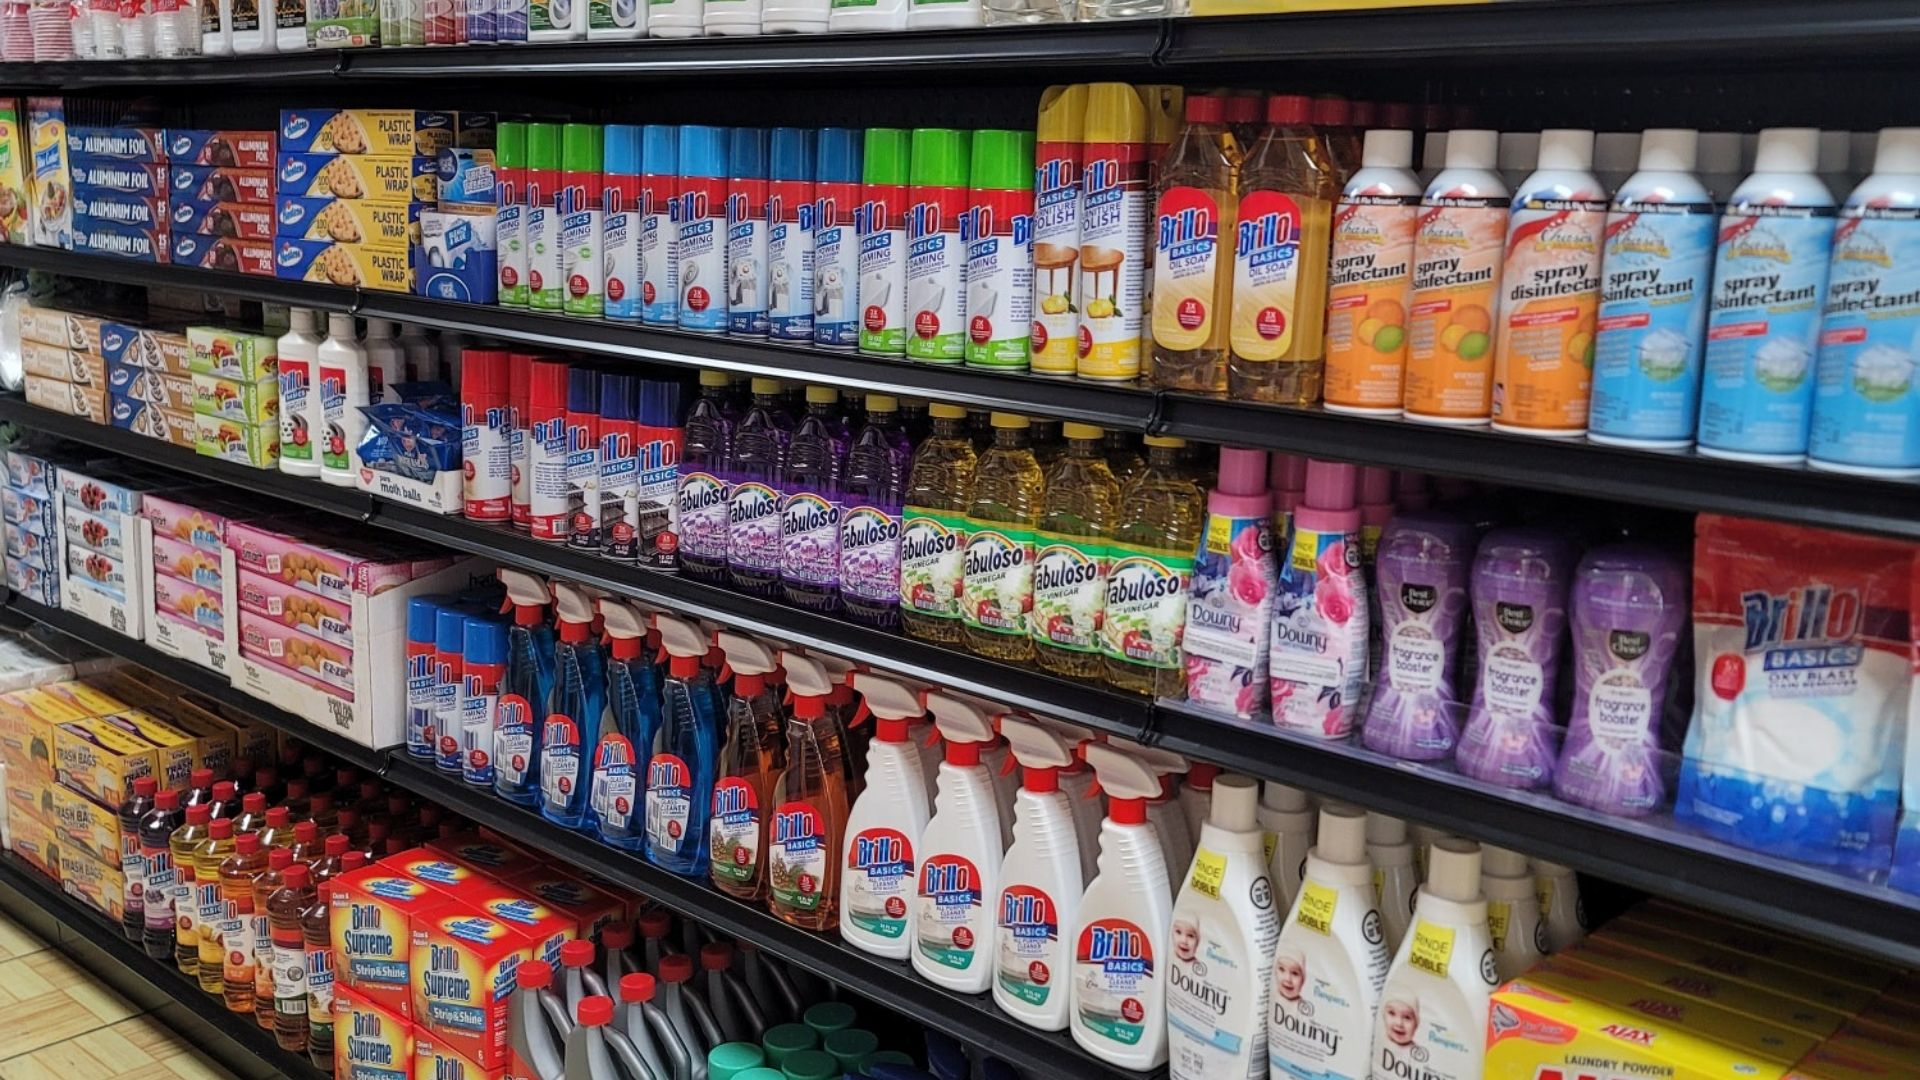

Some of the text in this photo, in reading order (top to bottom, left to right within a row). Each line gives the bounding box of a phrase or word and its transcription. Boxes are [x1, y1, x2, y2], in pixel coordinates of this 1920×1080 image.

[379, 120, 411, 133] PLASTIC
[85, 137, 128, 153] ALUMINUM
[130, 138, 146, 154] FOIL
[388, 133, 411, 145] WRAP
[88, 168, 130, 187] ALUMINUM
[132, 171, 149, 188] FOIL
[376, 166, 409, 179] PLASTIC
[385, 180, 409, 191] WRAP
[1040, 189, 1076, 206] BASICS
[89, 201, 130, 220] ALUMINUM
[132, 205, 149, 221] FOIL
[373, 212, 405, 224] PLASTIC
[382, 225, 405, 237] WRAP
[1159, 208, 1209, 250] Brillo
[1238, 212, 1292, 259] Brillo
[89, 233, 131, 250] ALUMINUM
[133, 237, 150, 252] FOIL
[1170, 241, 1212, 259] BASICS
[372, 257, 404, 269] PLASTIC
[1169, 253, 1211, 270] OIL SOAP
[1251, 248, 1293, 266] BASICS
[1336, 254, 1375, 270] spray
[1418, 258, 1459, 273] spray
[381, 270, 405, 282] WRAP
[1250, 260, 1292, 278] OIL SOAP
[1332, 263, 1406, 284] sinfectant
[1534, 264, 1588, 283] spray
[1610, 269, 1660, 287] spray
[1511, 276, 1600, 300] disinfecta
[1605, 278, 1693, 301] sinfectant
[1724, 275, 1780, 295] spray
[1716, 285, 1816, 309] sinfectant
[641, 468, 678, 486] BASICS
[381, 482, 422, 502] moth balls
[783, 508, 838, 536] Fabuloso
[911, 557, 939, 569] VINEGAR
[976, 572, 1006, 585] VINEGAR
[1046, 587, 1079, 600] VINEGAR
[1106, 575, 1179, 604] Fabuloso
[1408, 588, 1428, 598] Best
[1123, 601, 1160, 614] VINEGAR
[1504, 608, 1524, 618] Best
[1192, 604, 1240, 633] Downy
[1741, 586, 1859, 650] Brillo
[1278, 623, 1327, 654] Downy
[1618, 636, 1640, 646] Best
[1393, 646, 1439, 663] fragrance
[1771, 648, 1858, 668] BASICS
[1396, 660, 1433, 673] booster
[1488, 666, 1538, 687] fragrance
[1769, 669, 1856, 683] OXY BLAST
[1491, 680, 1530, 697] booster
[499, 702, 524, 724] Brillo
[1595, 695, 1646, 714] fragrance
[1600, 710, 1638, 725] booster
[503, 725, 525, 734] BASICS
[543, 720, 570, 746] Brillo
[507, 740, 530, 748] CLEANER
[602, 740, 627, 766] Brillo
[553, 761, 576, 769] CLEANER
[609, 766, 630, 775] BASICS
[651, 762, 680, 788] Brillo
[609, 781, 632, 790] CLEANER
[658, 788, 681, 797] BASICS
[661, 804, 687, 812] CLEANER
[716, 786, 746, 817] Brillo
[724, 813, 750, 823] BASICS
[777, 812, 814, 842] Brillo
[786, 839, 816, 850] BASICS
[858, 837, 901, 866] Brillo
[150, 872, 174, 885] BASIC
[869, 864, 904, 876] BASICS
[927, 862, 969, 894] Brillo
[1192, 875, 1218, 897] DOBLE
[937, 893, 971, 904] BASICS
[1302, 892, 1332, 913] RINDE
[352, 904, 380, 930] Brillo
[1004, 893, 1044, 925] Brillo
[1298, 911, 1328, 933] DOBLE
[1014, 926, 1048, 937] BASICS
[345, 930, 392, 957] Supreme
[1091, 926, 1140, 962] Brillo
[1416, 933, 1449, 953] RINDE
[431, 944, 459, 971] Brillo
[499, 953, 521, 973] Brillo
[1106, 960, 1144, 972] BASICS
[1411, 952, 1446, 975] DOBLE
[308, 973, 334, 985] BASIC
[355, 963, 406, 980] Strip&Shine
[424, 970, 470, 1002] Supreme
[1171, 964, 1232, 1016] Downy
[353, 1011, 381, 1037] Brillo
[433, 1008, 483, 1026] Strip&Shine
[1274, 1001, 1343, 1056] Downy
[1601, 1024, 1655, 1048] AJAX
[348, 1037, 392, 1065] Supreme
[1565, 1055, 1674, 1076] LAUNDRY POWDER
